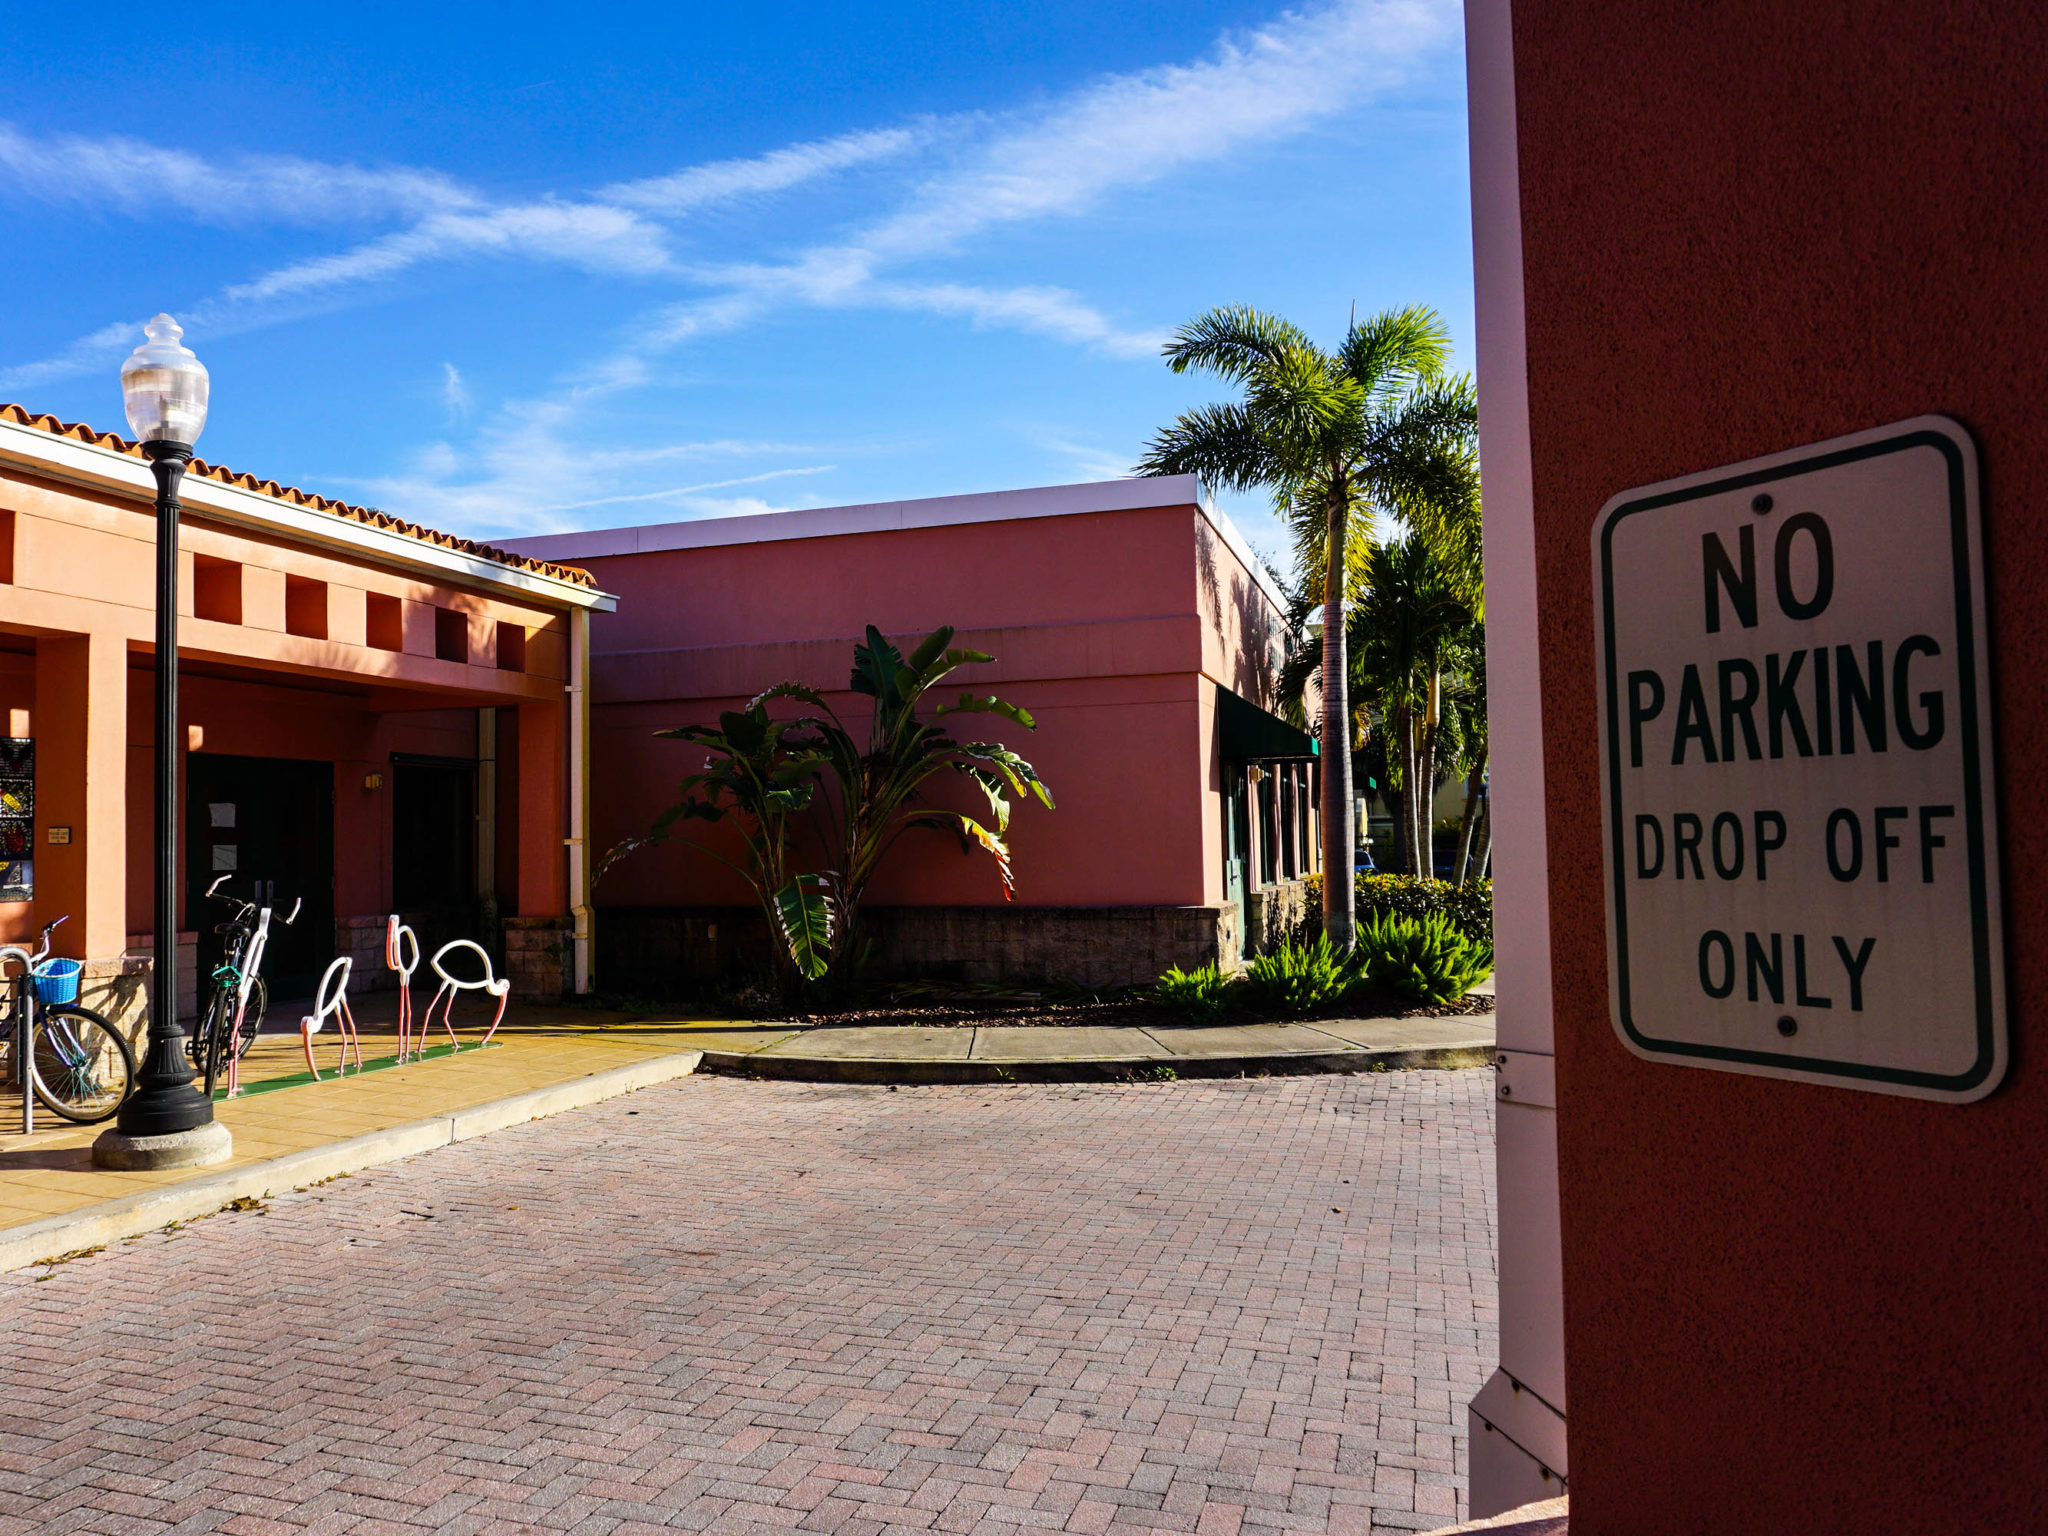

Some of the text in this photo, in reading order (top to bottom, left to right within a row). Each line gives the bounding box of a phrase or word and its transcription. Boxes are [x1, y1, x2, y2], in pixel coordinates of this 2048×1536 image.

[1702, 511, 1834, 634] NO
[1627, 634, 1946, 768] PARKING
[1635, 804, 1956, 884] DROP OFF
[1698, 929, 1877, 1012] ONLY
